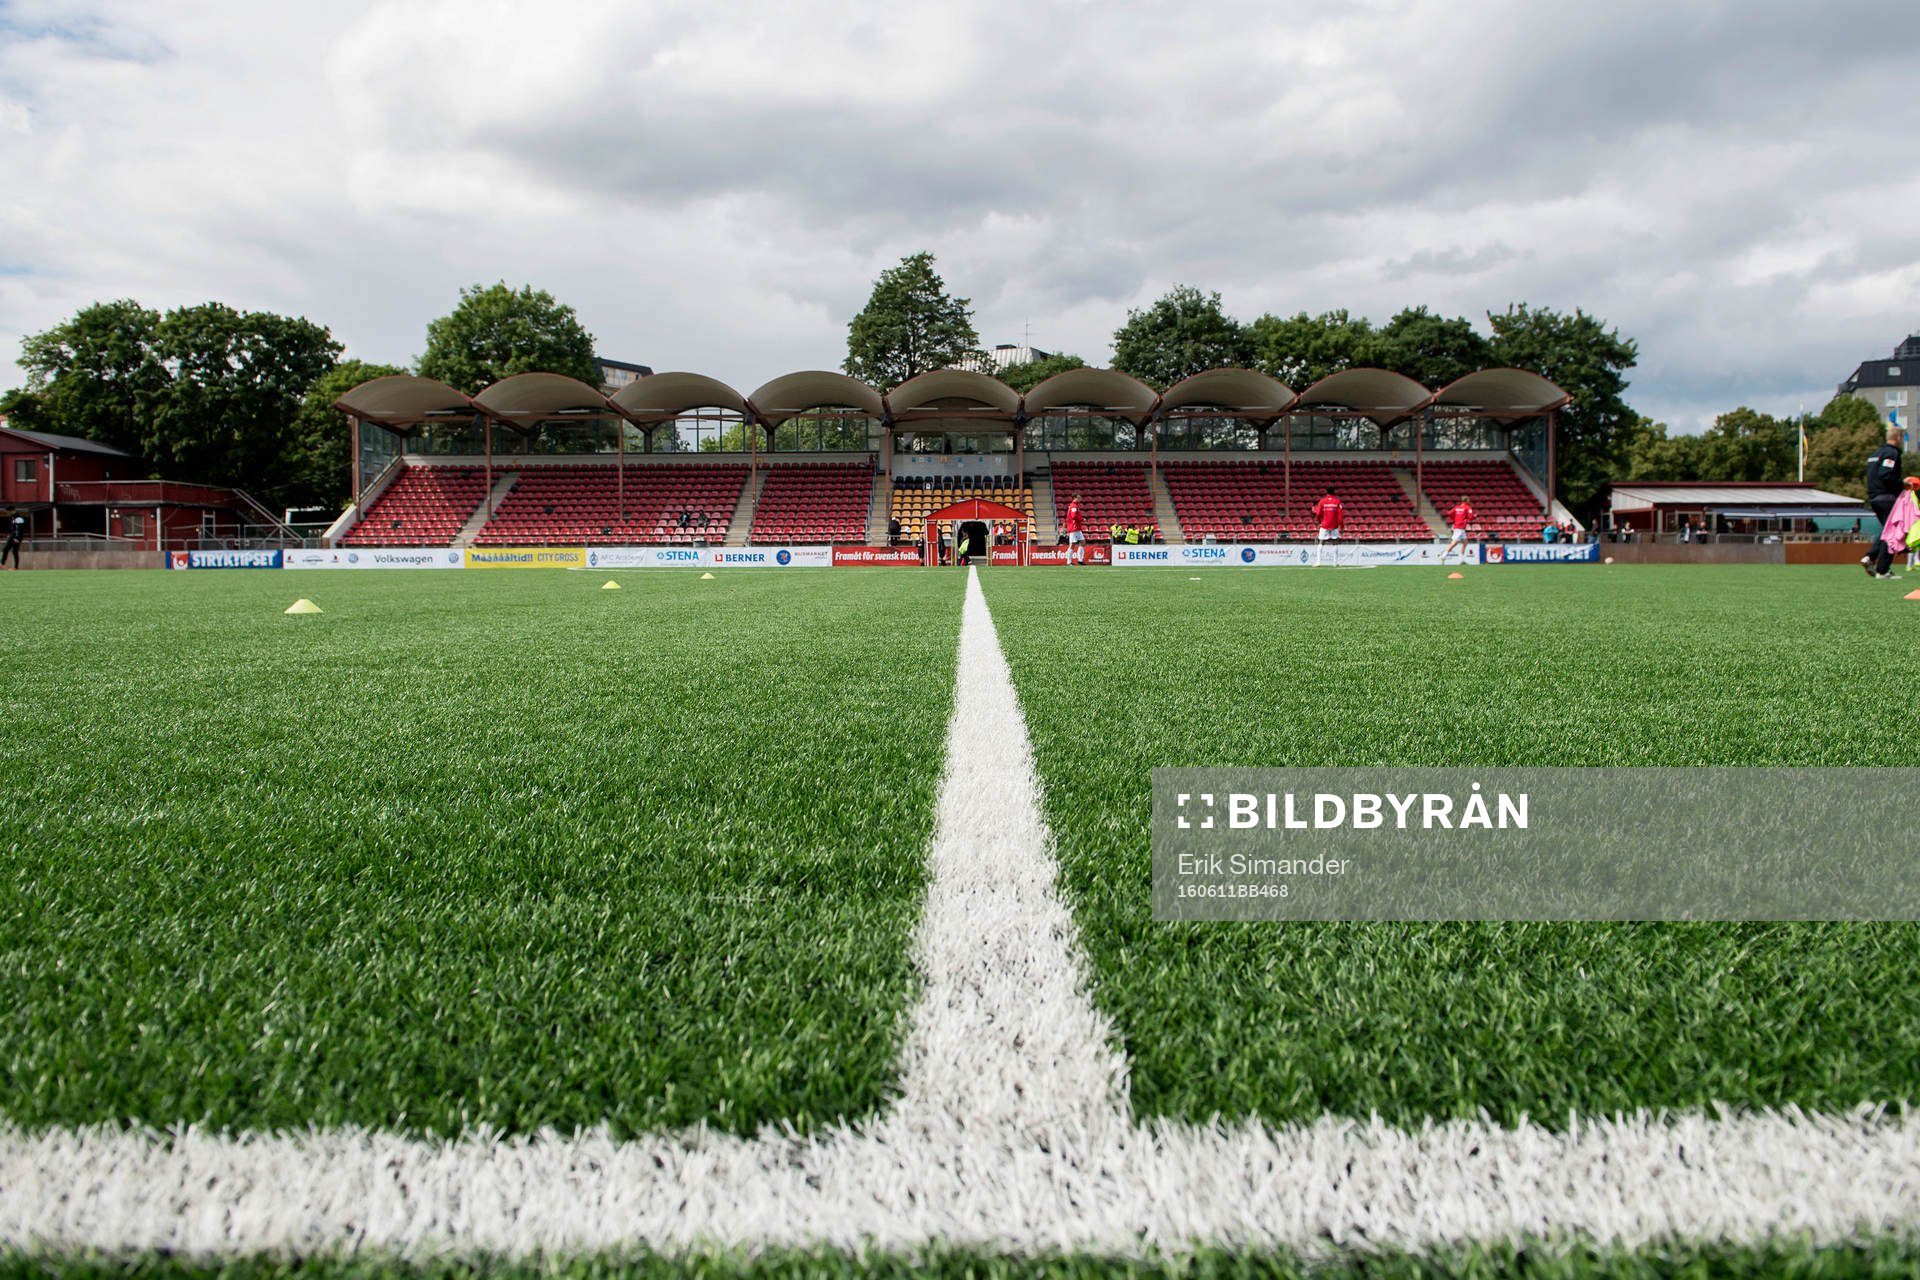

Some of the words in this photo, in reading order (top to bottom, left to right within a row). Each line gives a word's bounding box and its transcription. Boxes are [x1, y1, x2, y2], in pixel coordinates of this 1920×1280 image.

[537, 552, 554, 562] CITY
[555, 552, 579, 562] GROSS
[666, 551, 699, 560] STENA
[725, 553, 765, 562] BERNER
[835, 551, 862, 560] Framåt
[862, 551, 874, 560] för
[875, 551, 899, 560] svensk
[1031, 551, 1056, 560] svensk
[1129, 551, 1168, 560] BERNER
[1192, 548, 1226, 558] STENA
[1507, 547, 1590, 560] STRYKTIPSET
[192, 551, 275, 567] STRYKTIPSET
[374, 554, 433, 565] Volkswagen
